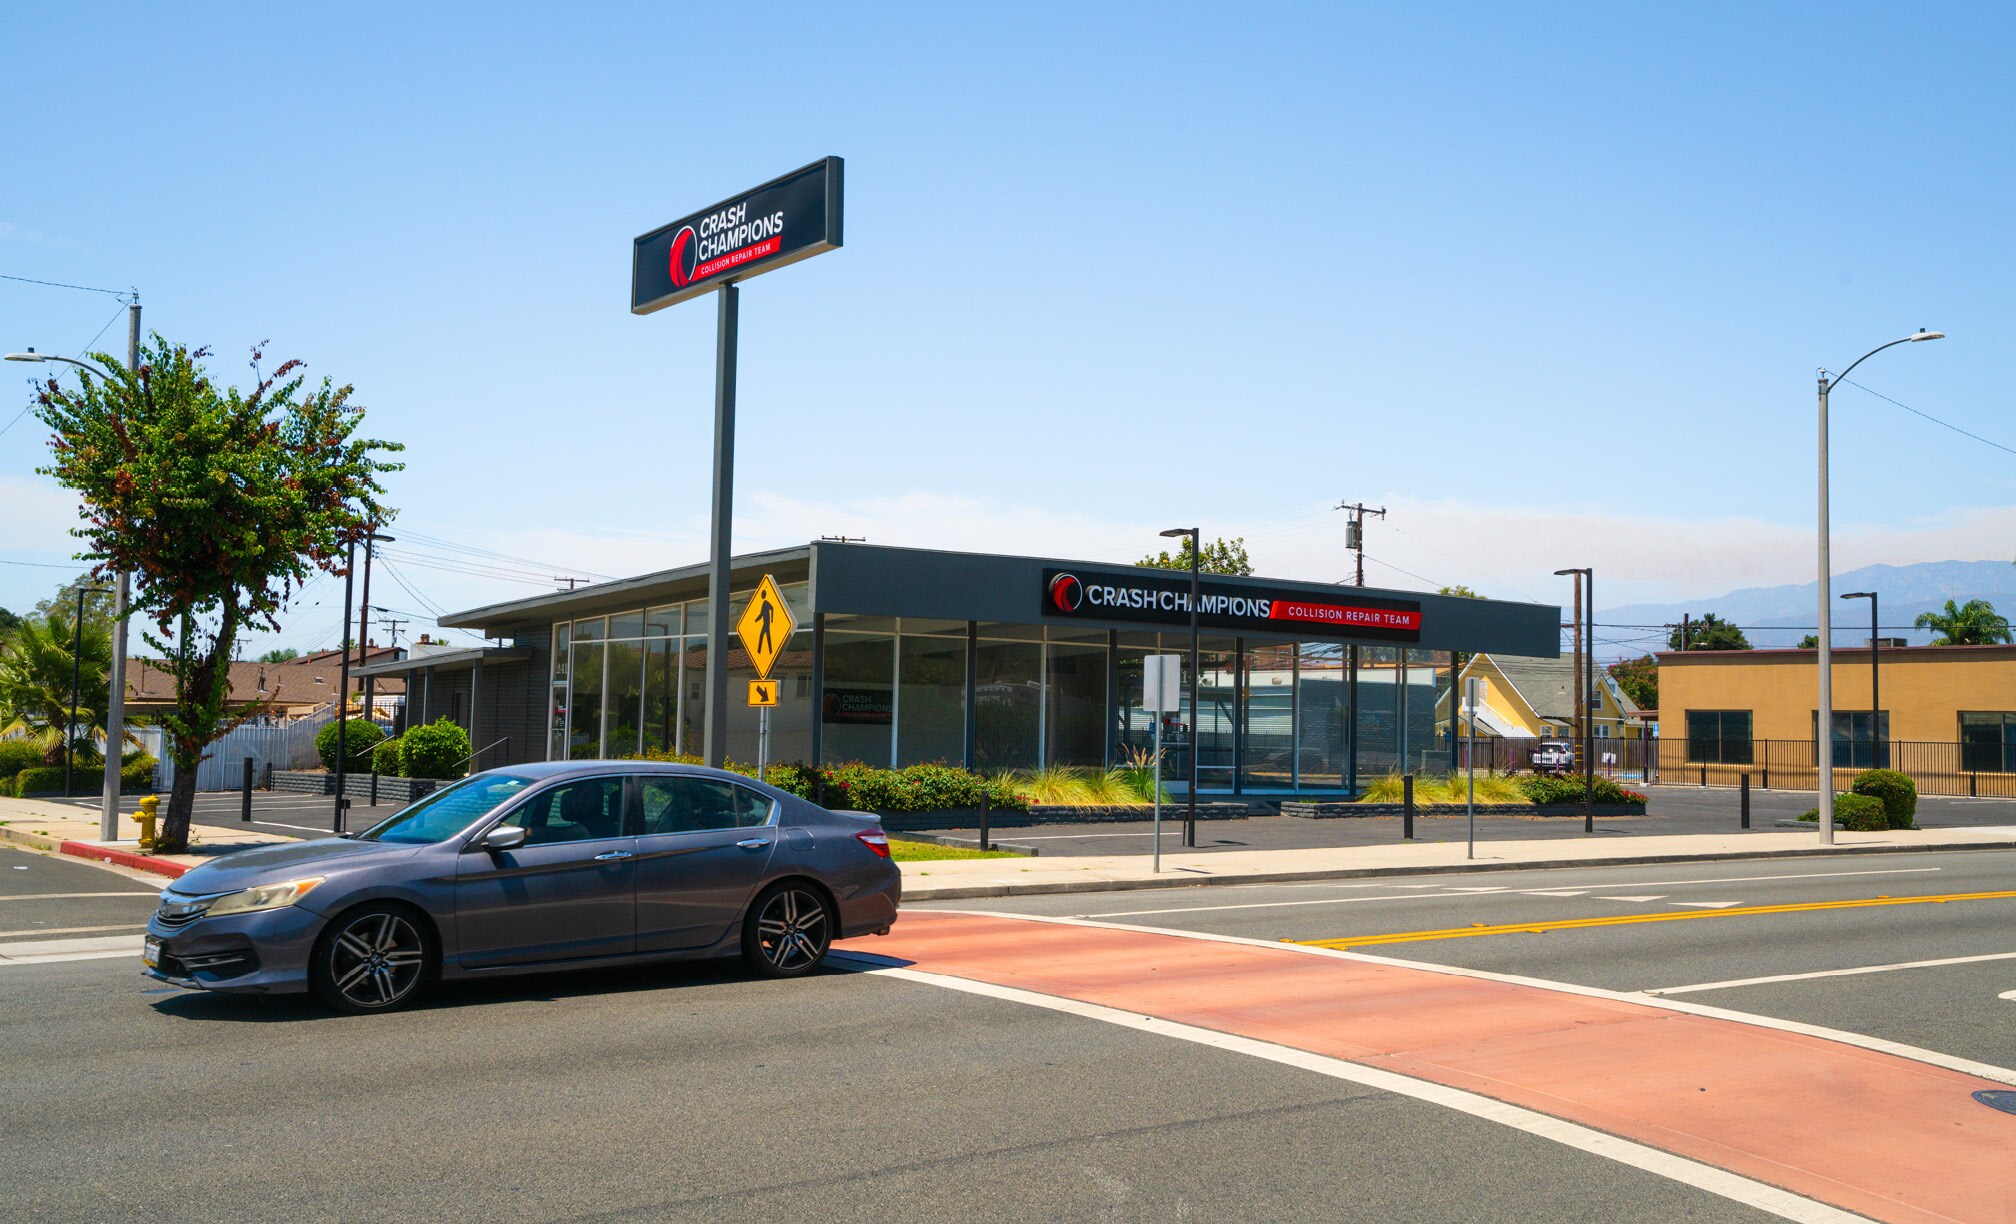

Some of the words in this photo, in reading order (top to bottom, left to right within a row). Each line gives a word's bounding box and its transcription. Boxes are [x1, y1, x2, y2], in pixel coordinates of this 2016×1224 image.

[700, 202, 747, 238] CRASH
[698, 211, 784, 261] CHAMPIONS
[701, 257, 730, 275] COLLISION
[731, 249, 753, 263] REPAIR
[753, 242, 771, 256] TEAM
[1087, 585, 1156, 610] CRASH
[1288, 606, 1342, 620] COLLISION
[1346, 611, 1380, 623] REPAIR
[1384, 614, 1410, 625] TEAM
[842, 694, 872, 704] CRASH
[842, 703, 893, 713] CHAMPIONS
